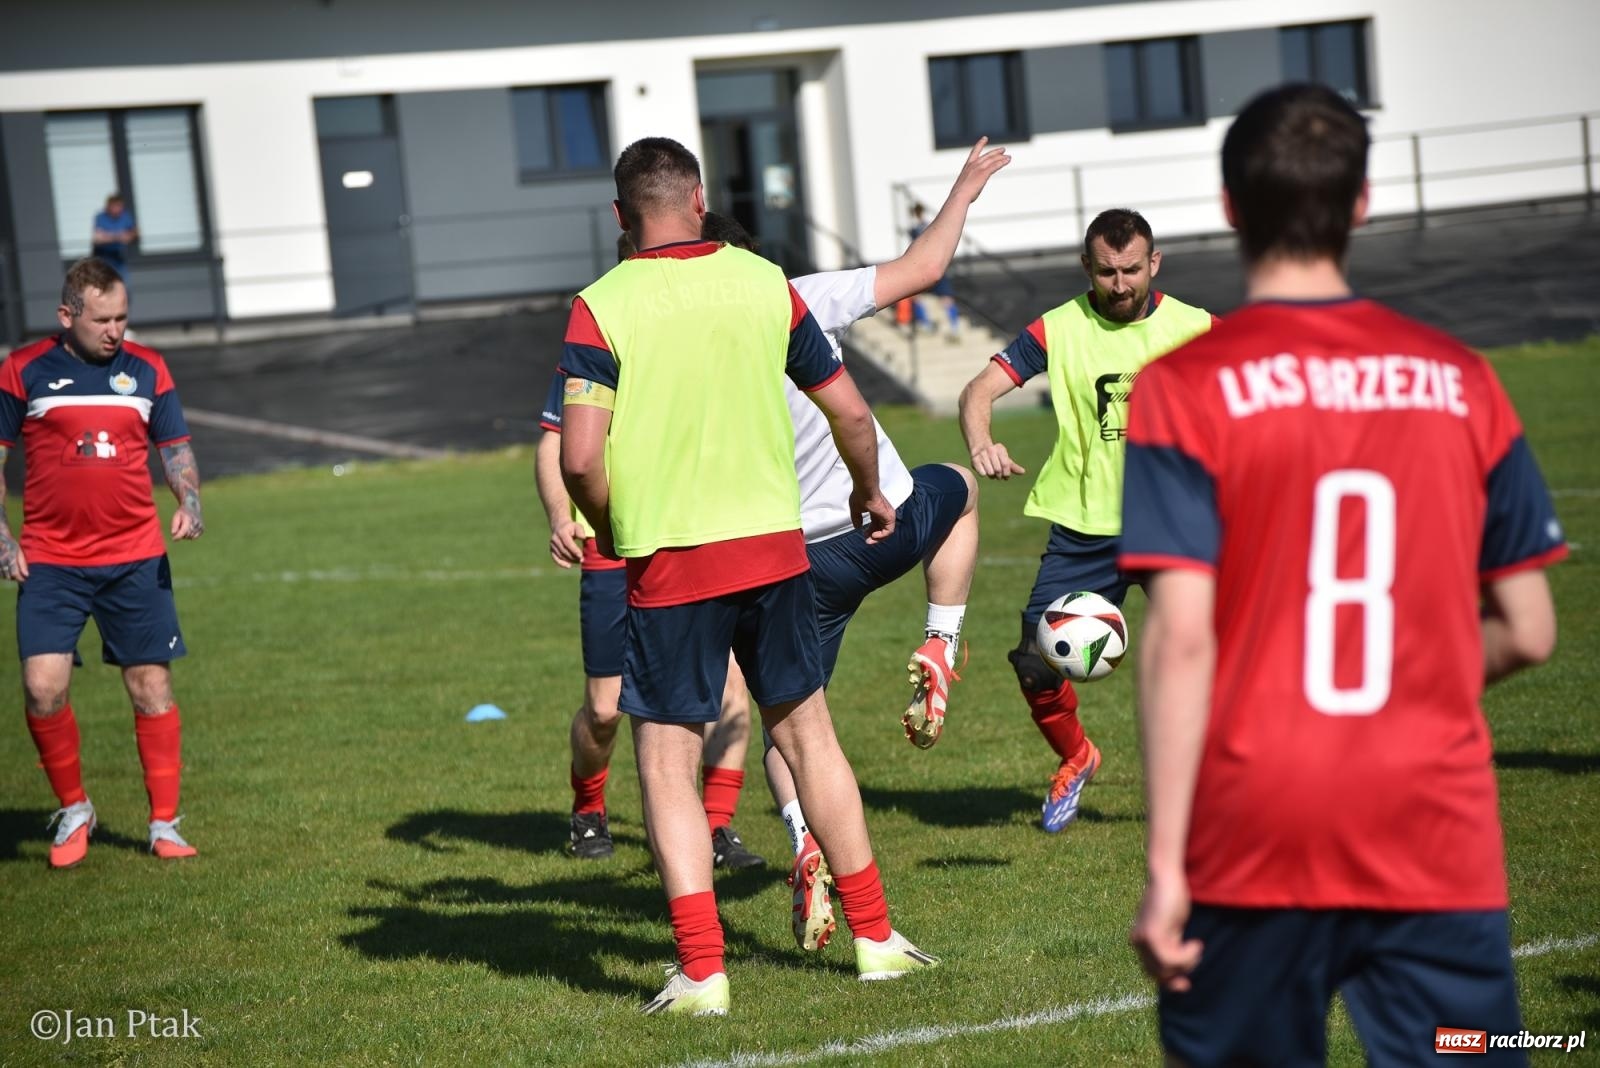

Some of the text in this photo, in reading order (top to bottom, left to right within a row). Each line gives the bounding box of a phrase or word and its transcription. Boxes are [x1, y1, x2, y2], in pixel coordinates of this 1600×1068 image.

[1218, 353, 1468, 418] LKS BRZEZIE
[1304, 468, 1396, 717] 8
